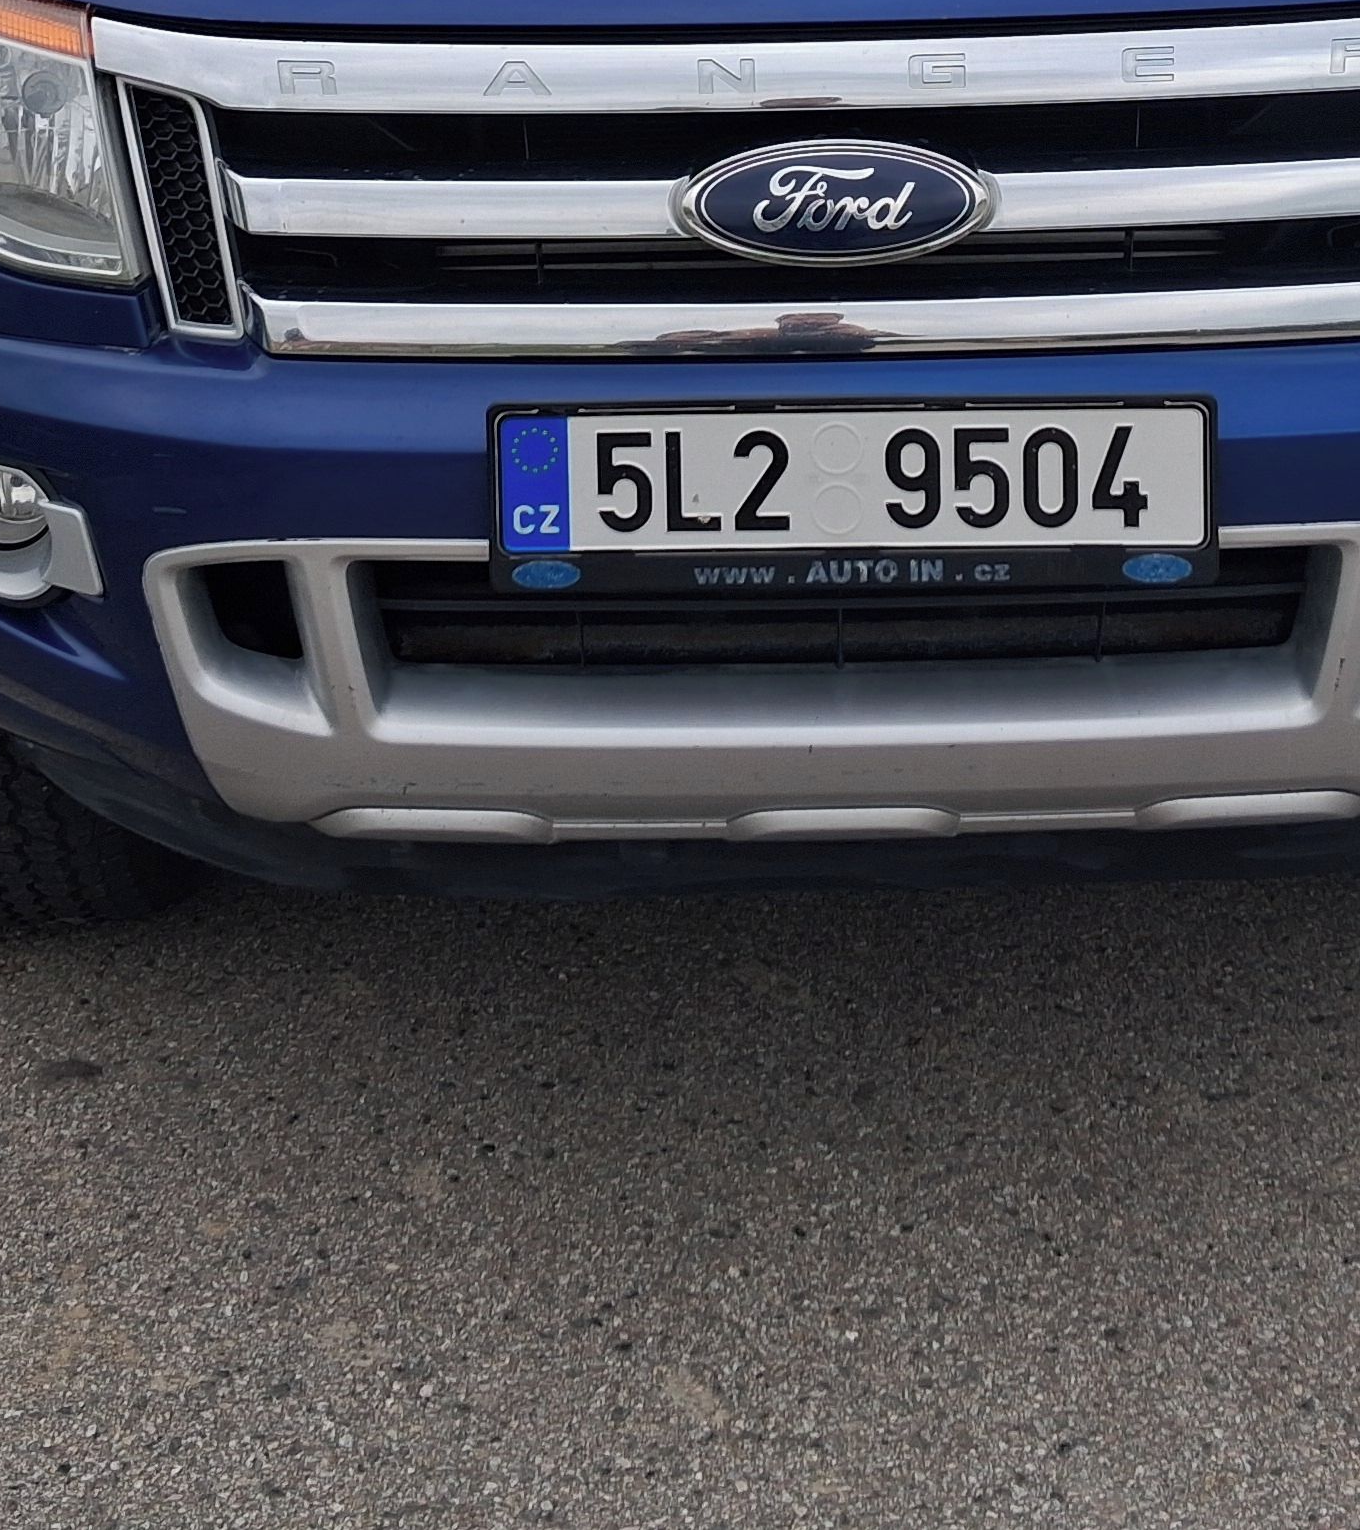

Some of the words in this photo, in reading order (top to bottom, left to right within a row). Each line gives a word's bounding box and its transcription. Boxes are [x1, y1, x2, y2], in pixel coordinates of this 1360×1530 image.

[752, 165, 916, 233] Ford
[595, 431, 791, 532] 5L2
[884, 425, 1149, 529] 9504
[513, 505, 559, 534] CZ
